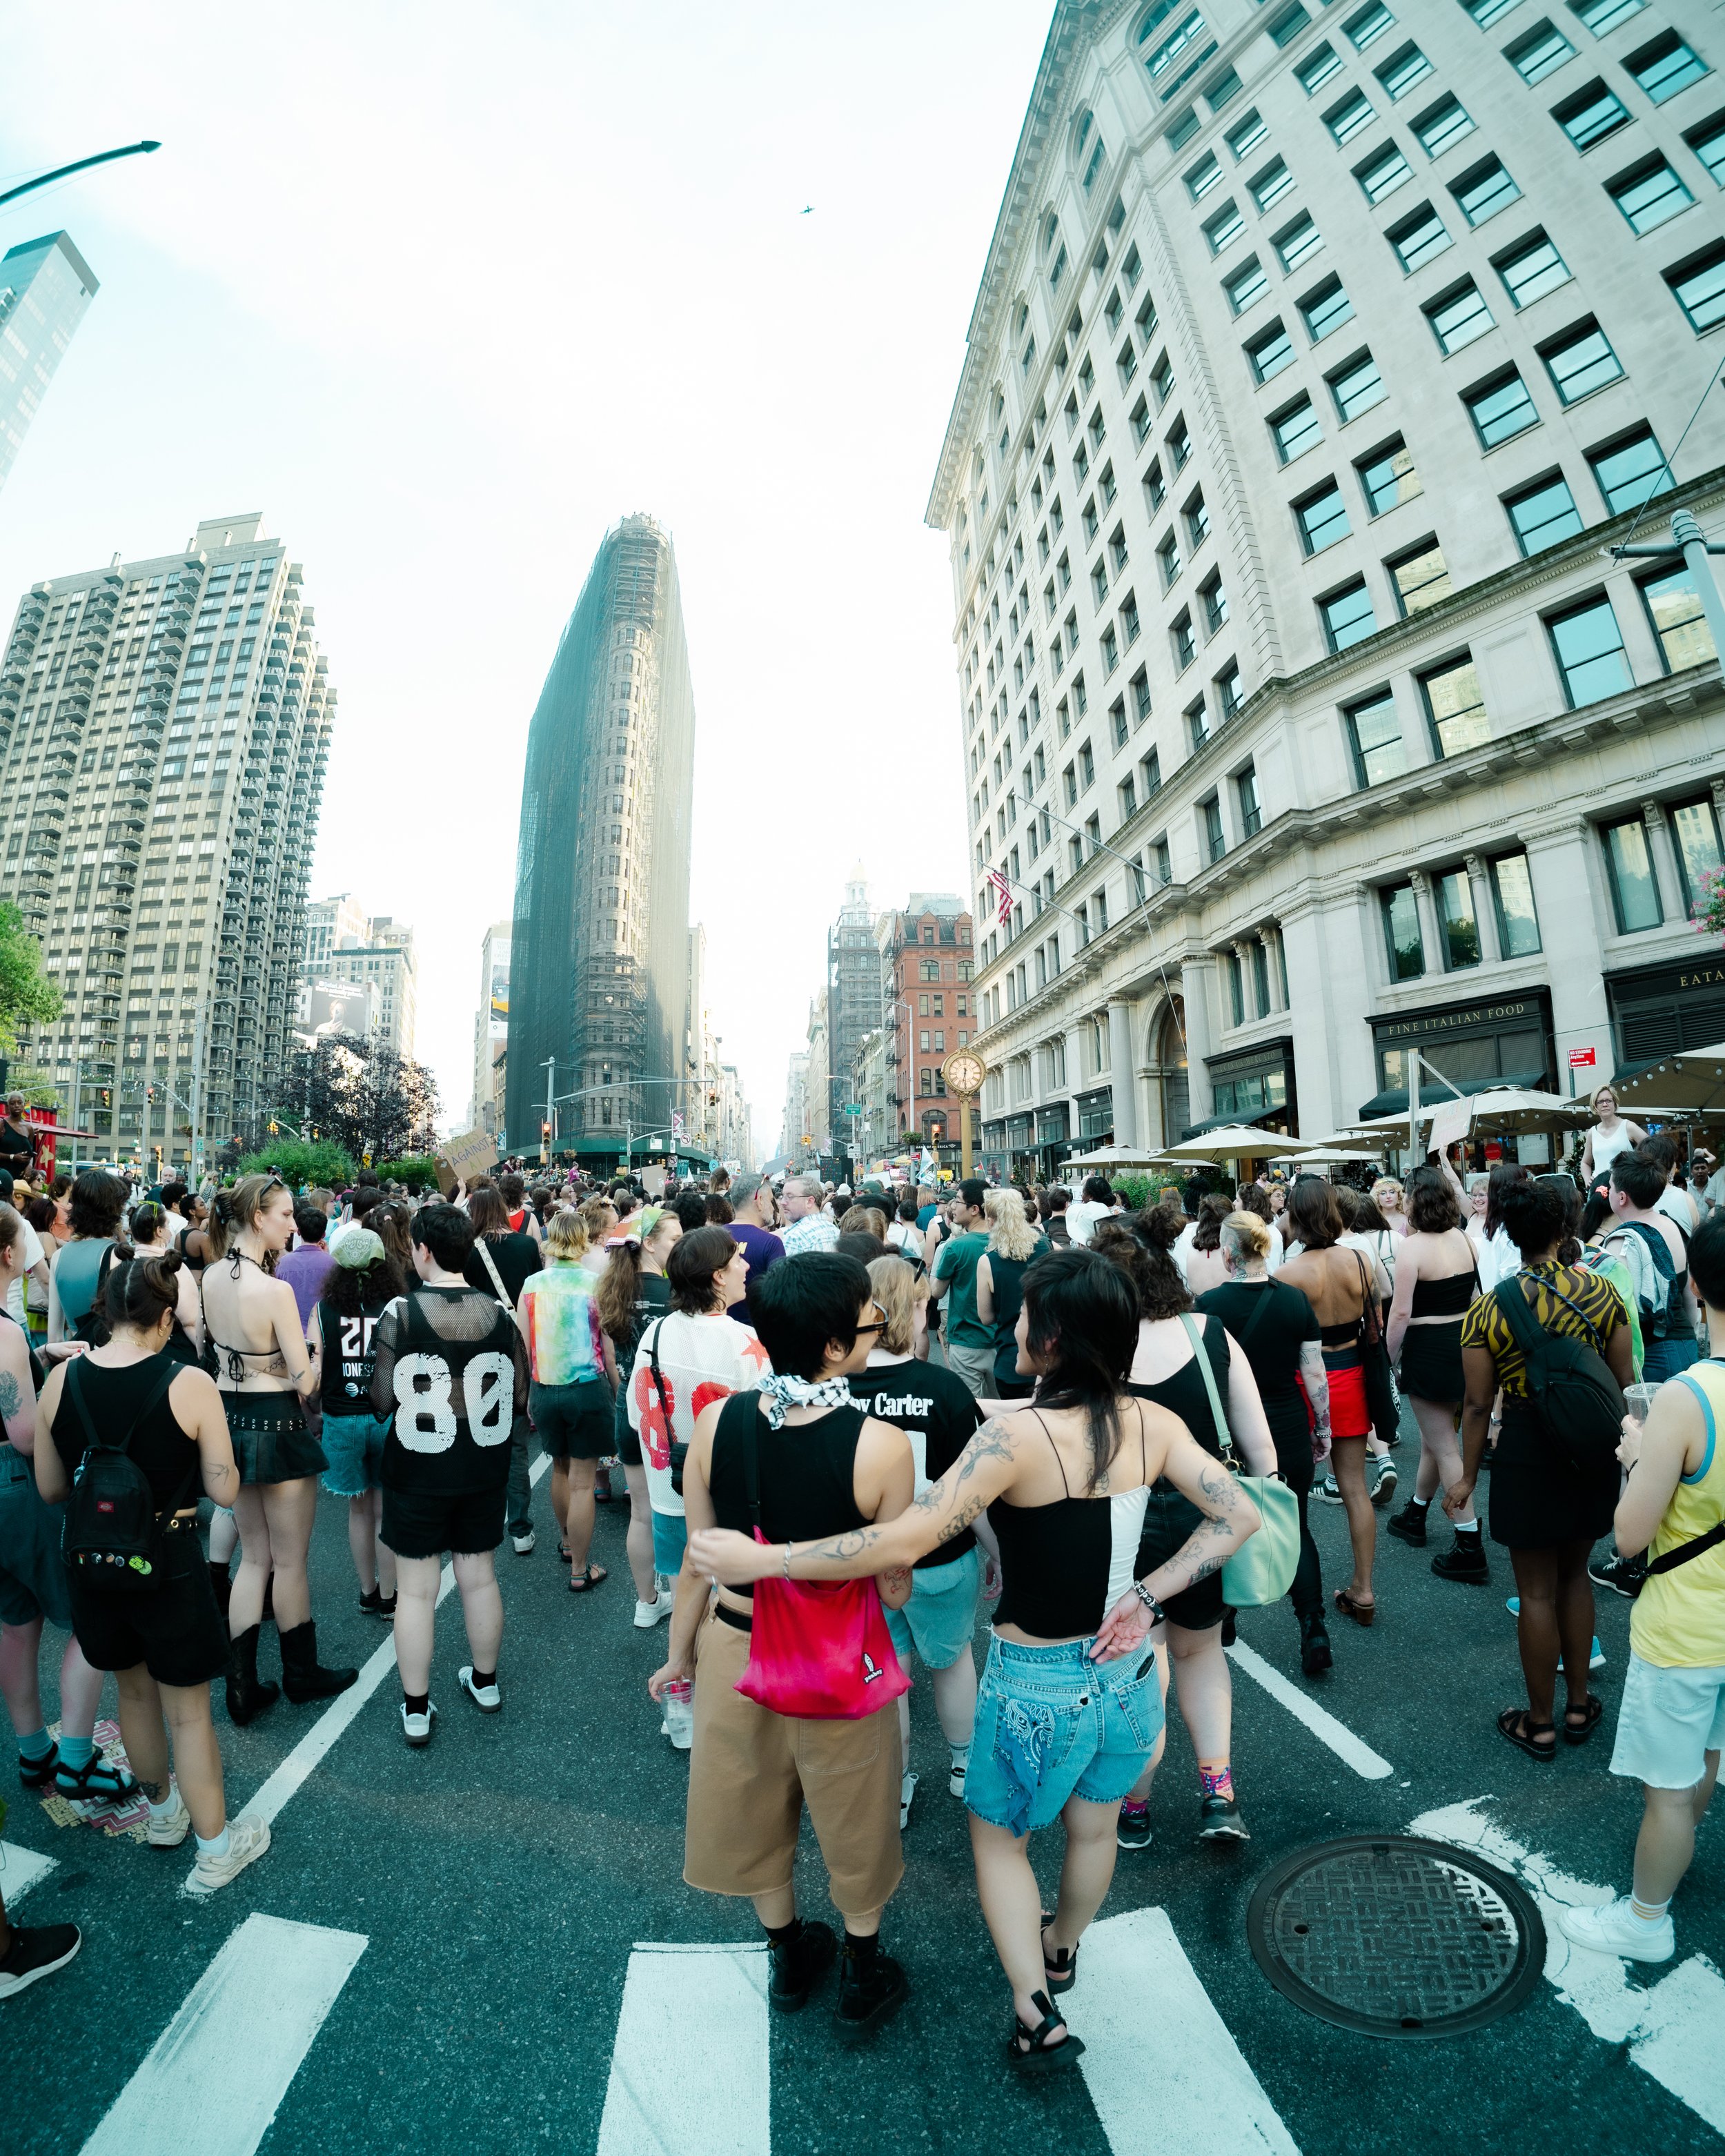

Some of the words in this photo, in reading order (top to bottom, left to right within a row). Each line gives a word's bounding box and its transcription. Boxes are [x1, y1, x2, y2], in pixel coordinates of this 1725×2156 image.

[1679, 969, 1725, 987] EATA
[1388, 1022, 1419, 1035] FINE
[1424, 1011, 1481, 1029] ITALIAN
[1488, 1004, 1524, 1018] FOOD
[1245, 1051, 1276, 1065] MERCATO
[445, 1131, 480, 1155] DYKES
[451, 1136, 491, 1167] AGAINST
[469, 1155, 483, 1171] AI
[393, 1352, 515, 1454] 80
[874, 1392, 934, 1416] Carter
